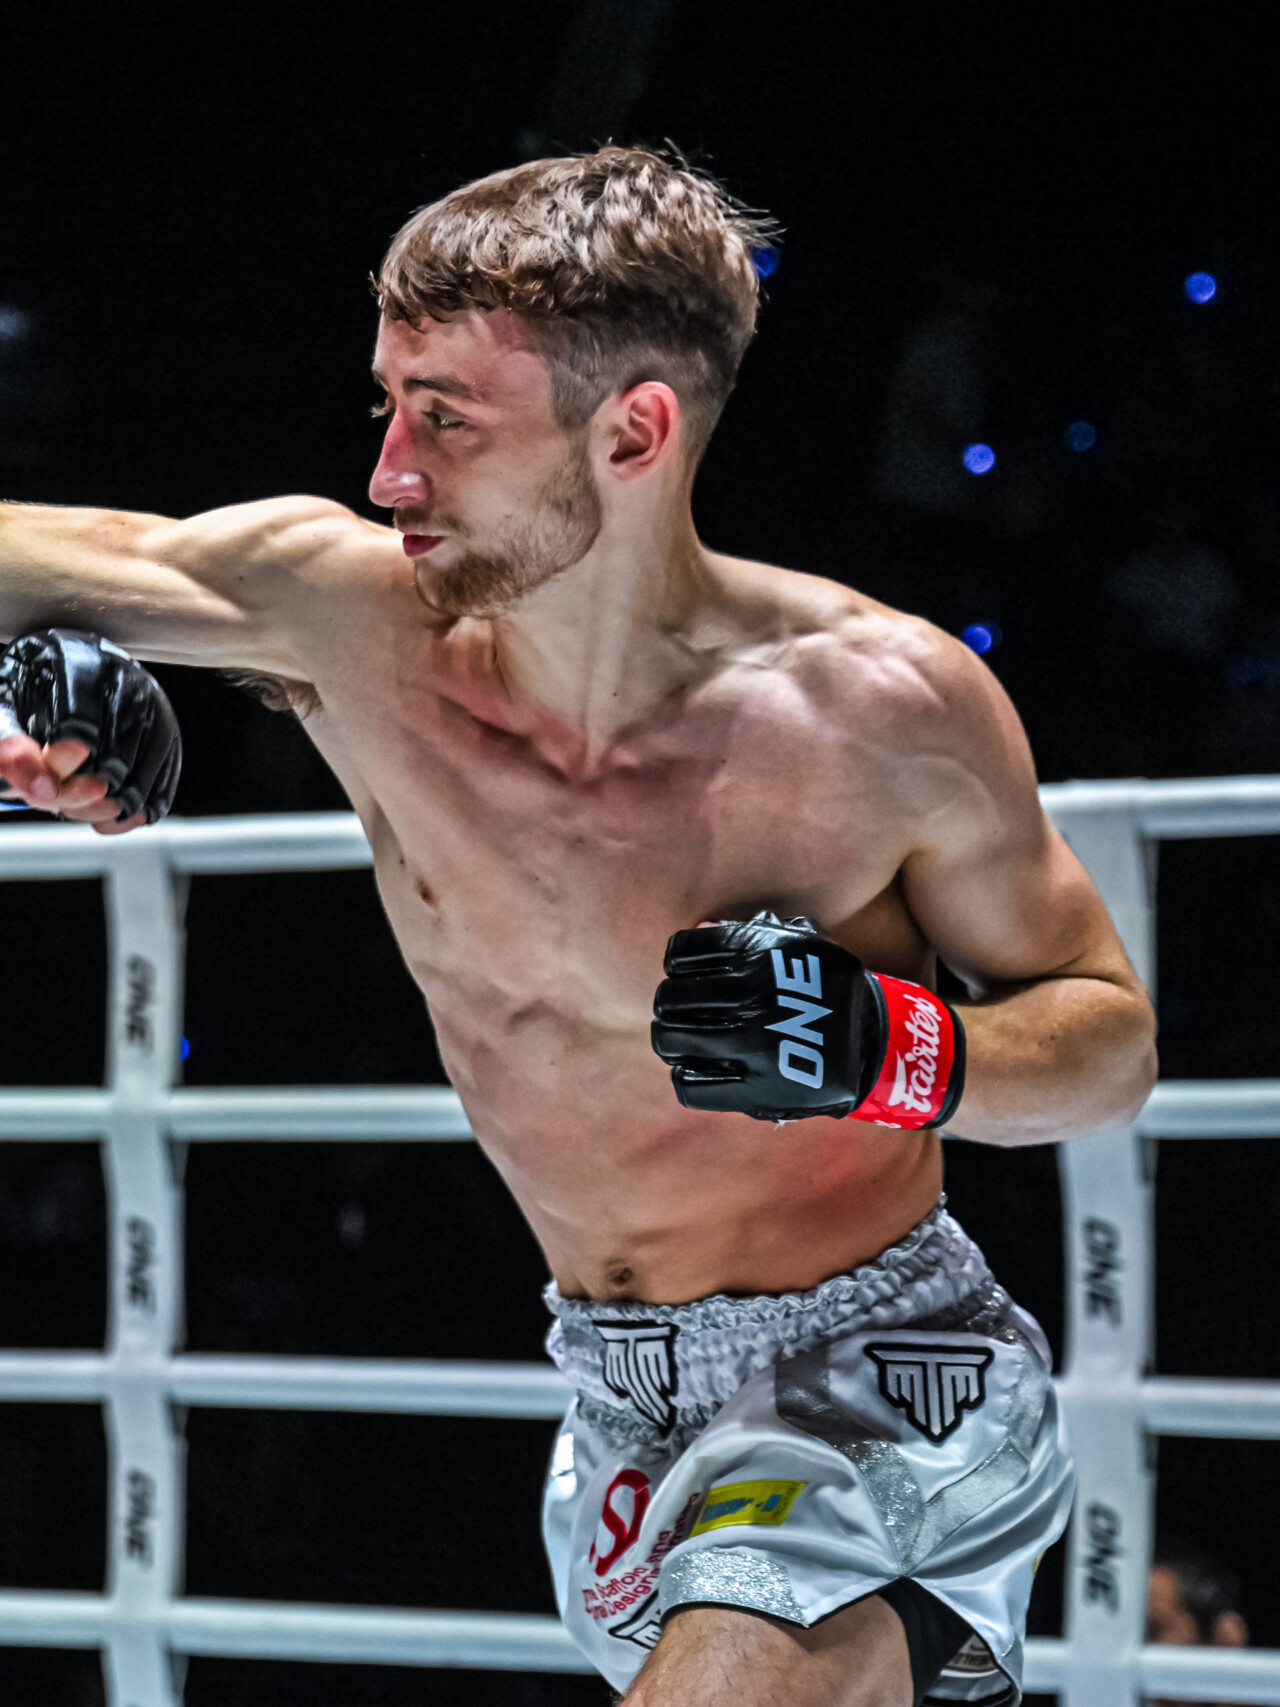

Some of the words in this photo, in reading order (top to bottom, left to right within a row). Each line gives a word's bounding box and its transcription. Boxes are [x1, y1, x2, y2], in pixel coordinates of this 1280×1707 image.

[764, 949, 834, 1089] ONE
[888, 994, 942, 1113] Fairtex
[1082, 1217, 1123, 1330] ONE
[1082, 1500, 1123, 1616] ONE
